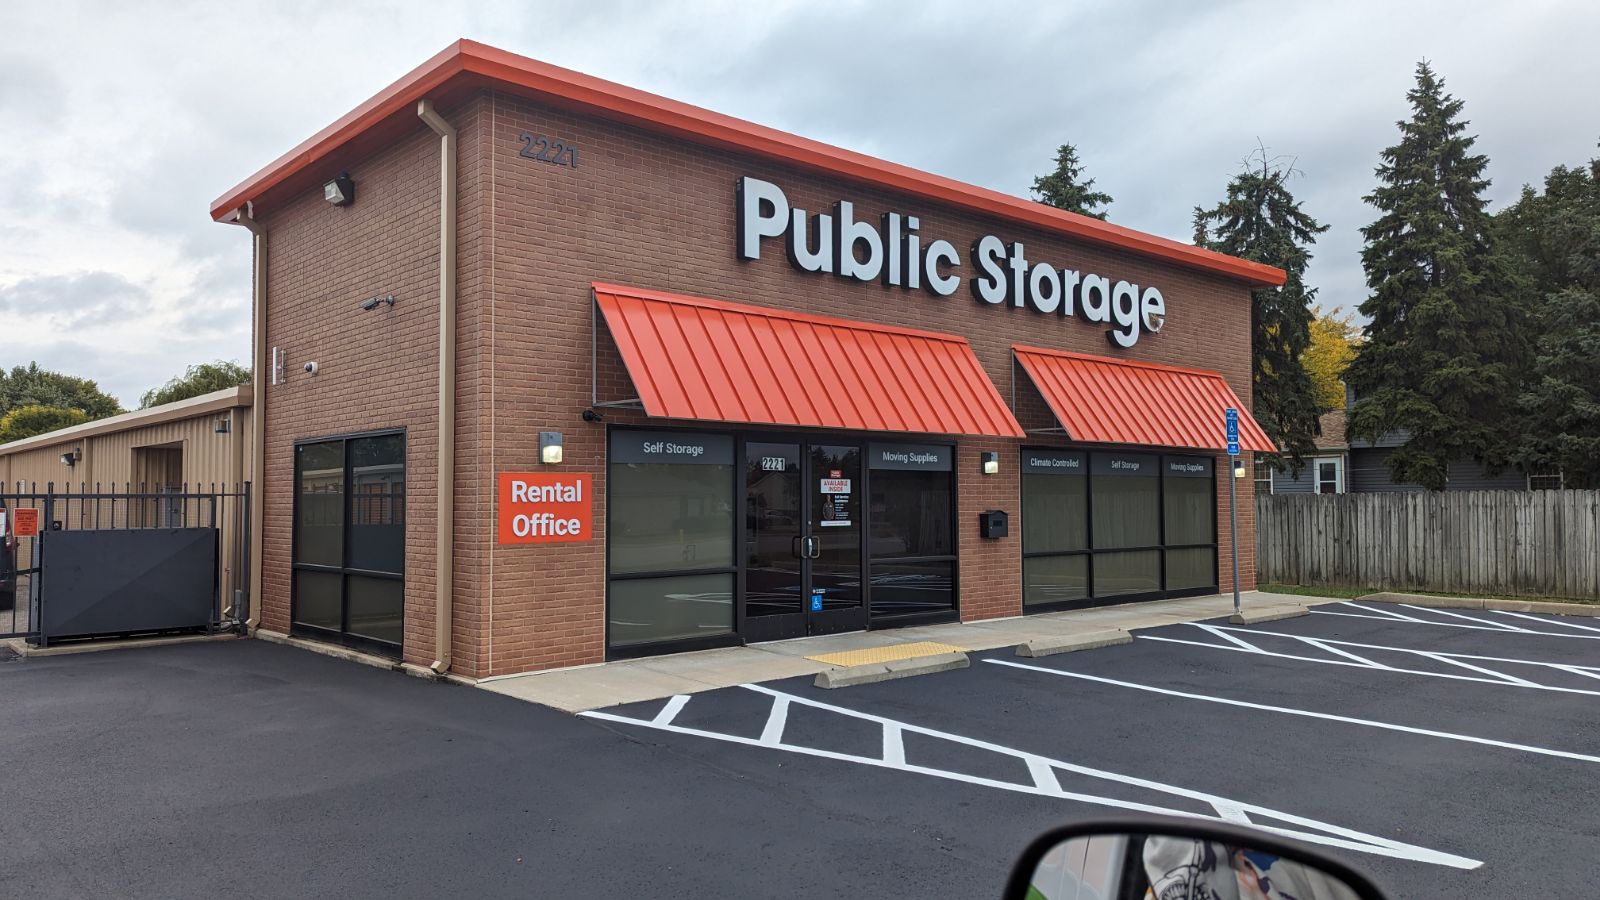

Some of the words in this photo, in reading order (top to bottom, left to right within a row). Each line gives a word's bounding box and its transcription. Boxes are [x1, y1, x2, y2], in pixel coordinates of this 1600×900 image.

[519, 131, 577, 168] 2221
[737, 176, 960, 296] Public
[971, 235, 1165, 348] Storage
[643, 442, 663, 454] Self
[665, 443, 704, 457] Storage
[762, 457, 785, 471] 2221
[882, 451, 908, 463] Moving
[909, 452, 938, 464] Supplies
[1030, 457, 1051, 467] Climate
[1052, 458, 1079, 468] Controlled
[1111, 460, 1120, 469] Self
[1121, 461, 1140, 471] Storage
[1170, 462, 1186, 472] Moving
[1186, 463, 1204, 473] Supplies
[511, 479, 582, 503] Rental
[512, 513, 581, 537] Office
